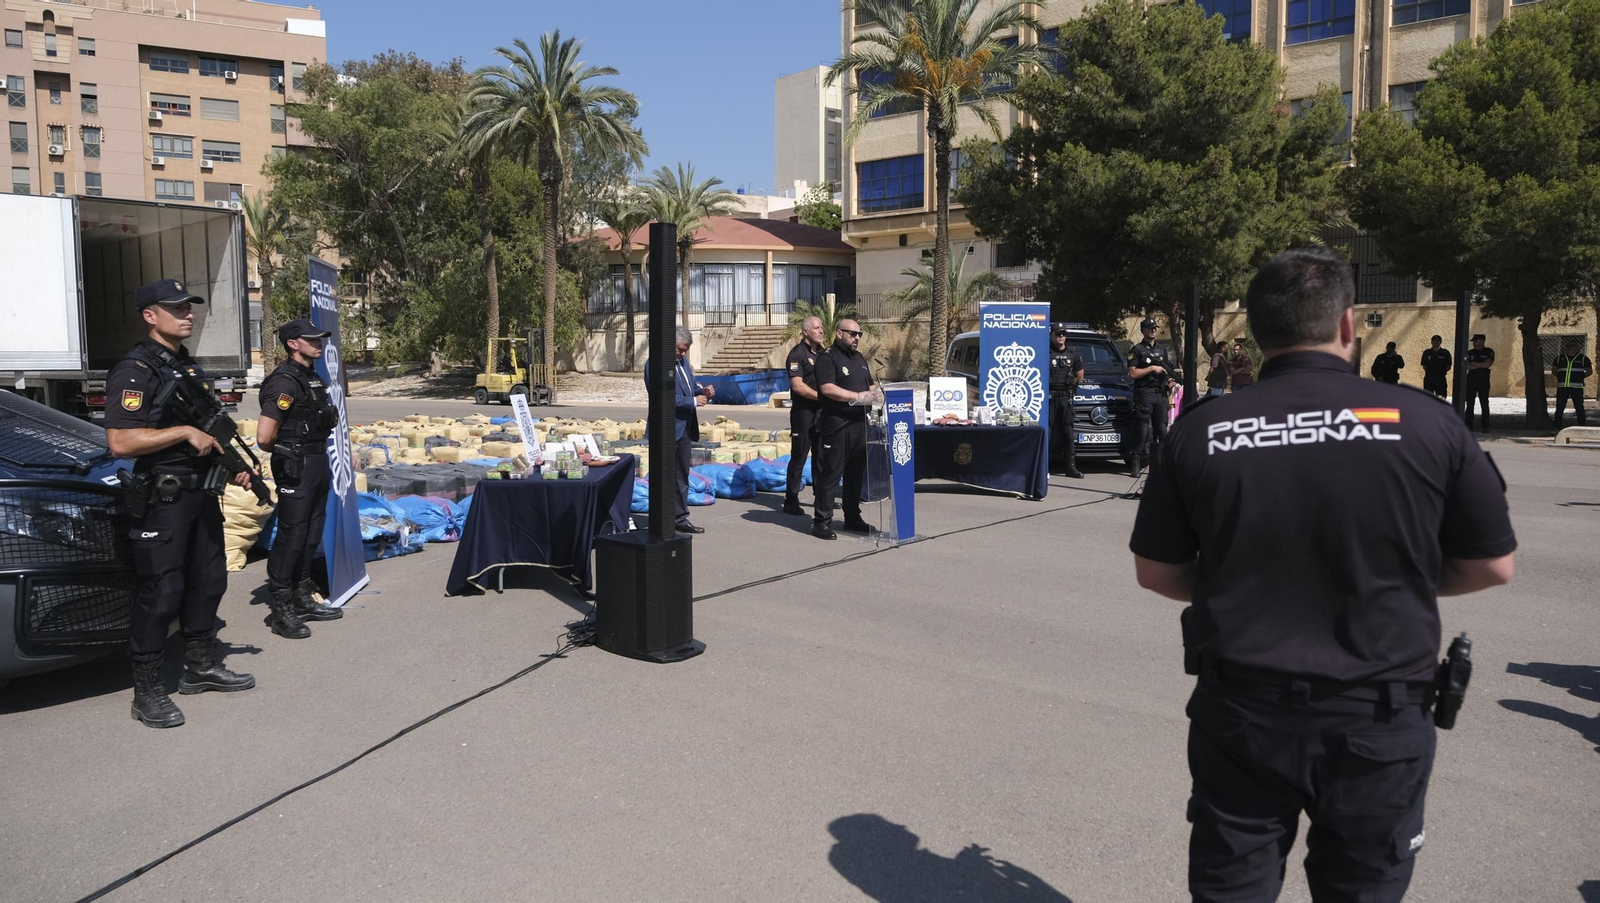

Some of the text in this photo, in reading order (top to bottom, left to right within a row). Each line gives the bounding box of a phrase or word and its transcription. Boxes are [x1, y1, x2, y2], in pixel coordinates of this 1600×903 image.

[983, 313, 1033, 321] POLICIA
[983, 321, 1046, 329] NACIONAL
[934, 389, 963, 401] 200
[1208, 408, 1360, 439] POLICIA
[1208, 424, 1401, 455] NACIONAL
